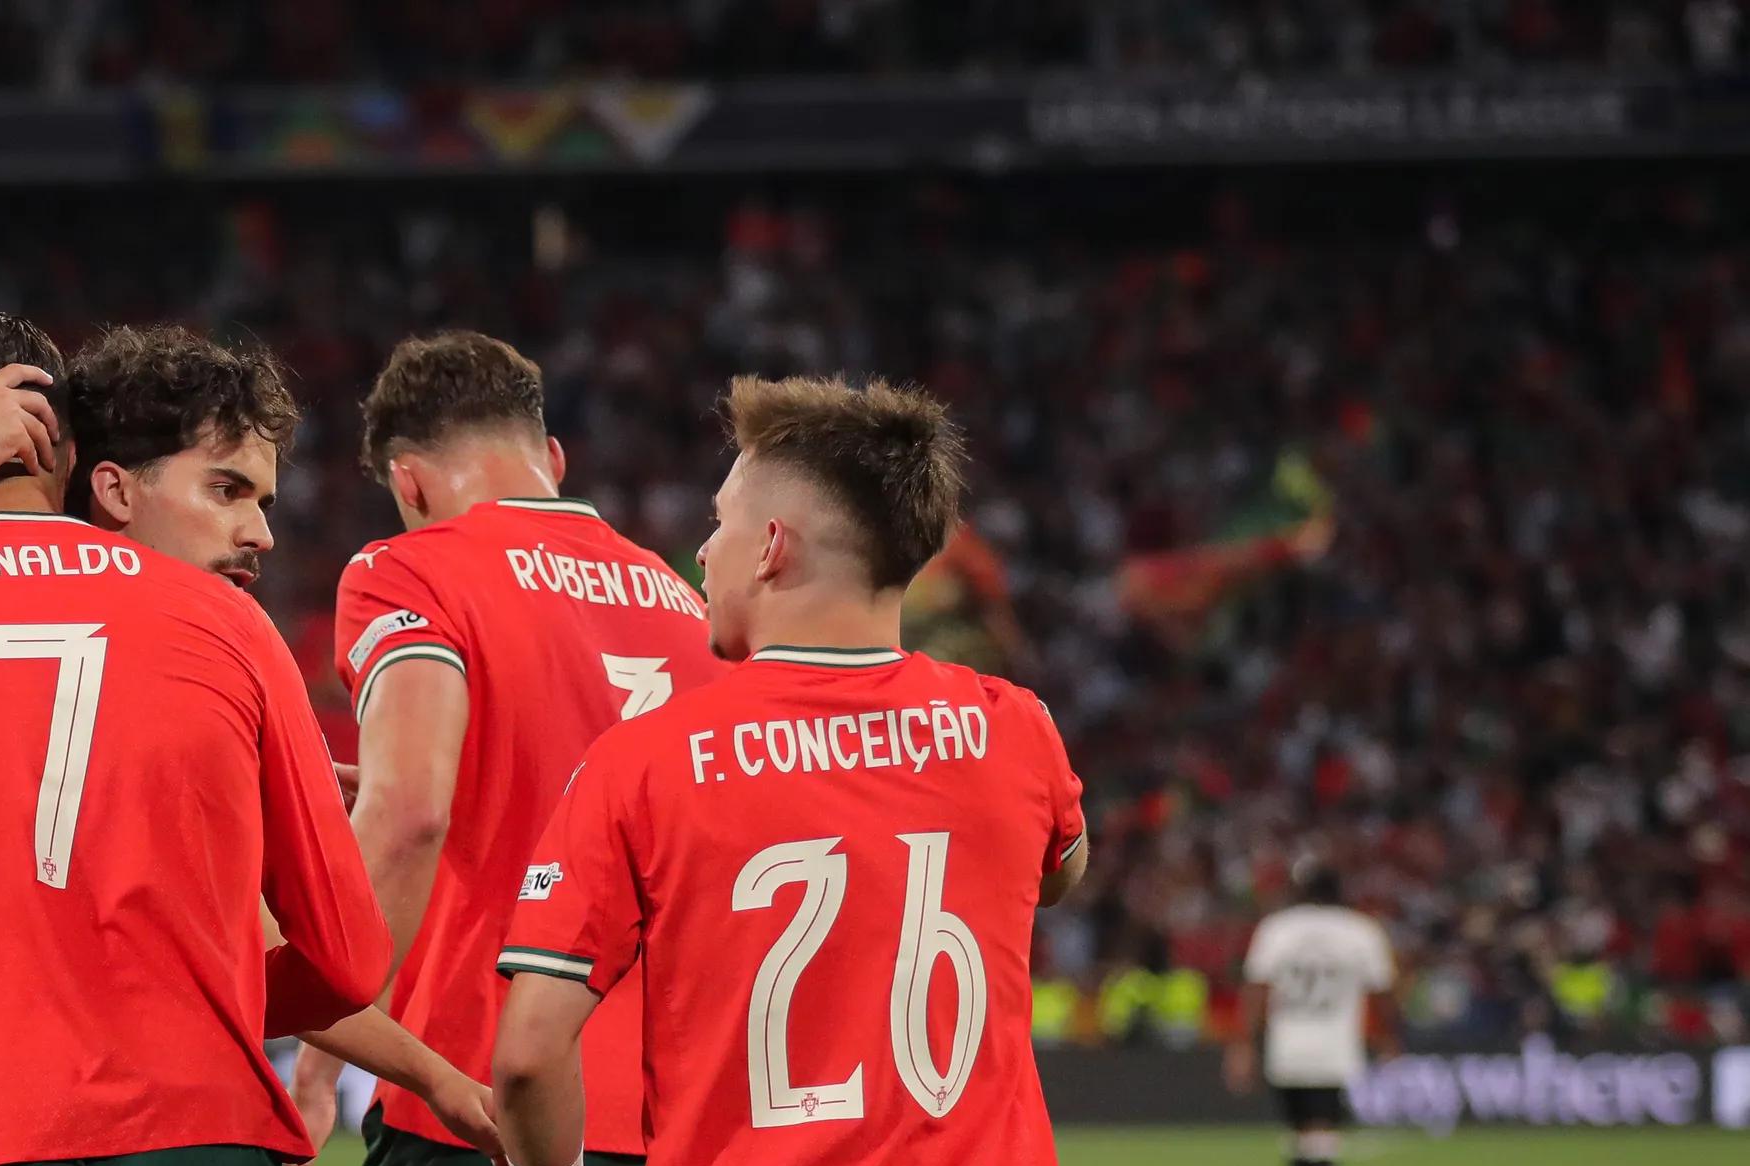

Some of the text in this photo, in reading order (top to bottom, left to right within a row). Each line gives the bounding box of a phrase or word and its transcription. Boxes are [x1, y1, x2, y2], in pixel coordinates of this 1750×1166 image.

[505, 542, 705, 621] RÚBEN DIAS
[689, 699, 989, 784] F. CONCEIÇÃO
[731, 830, 988, 1129] 26
